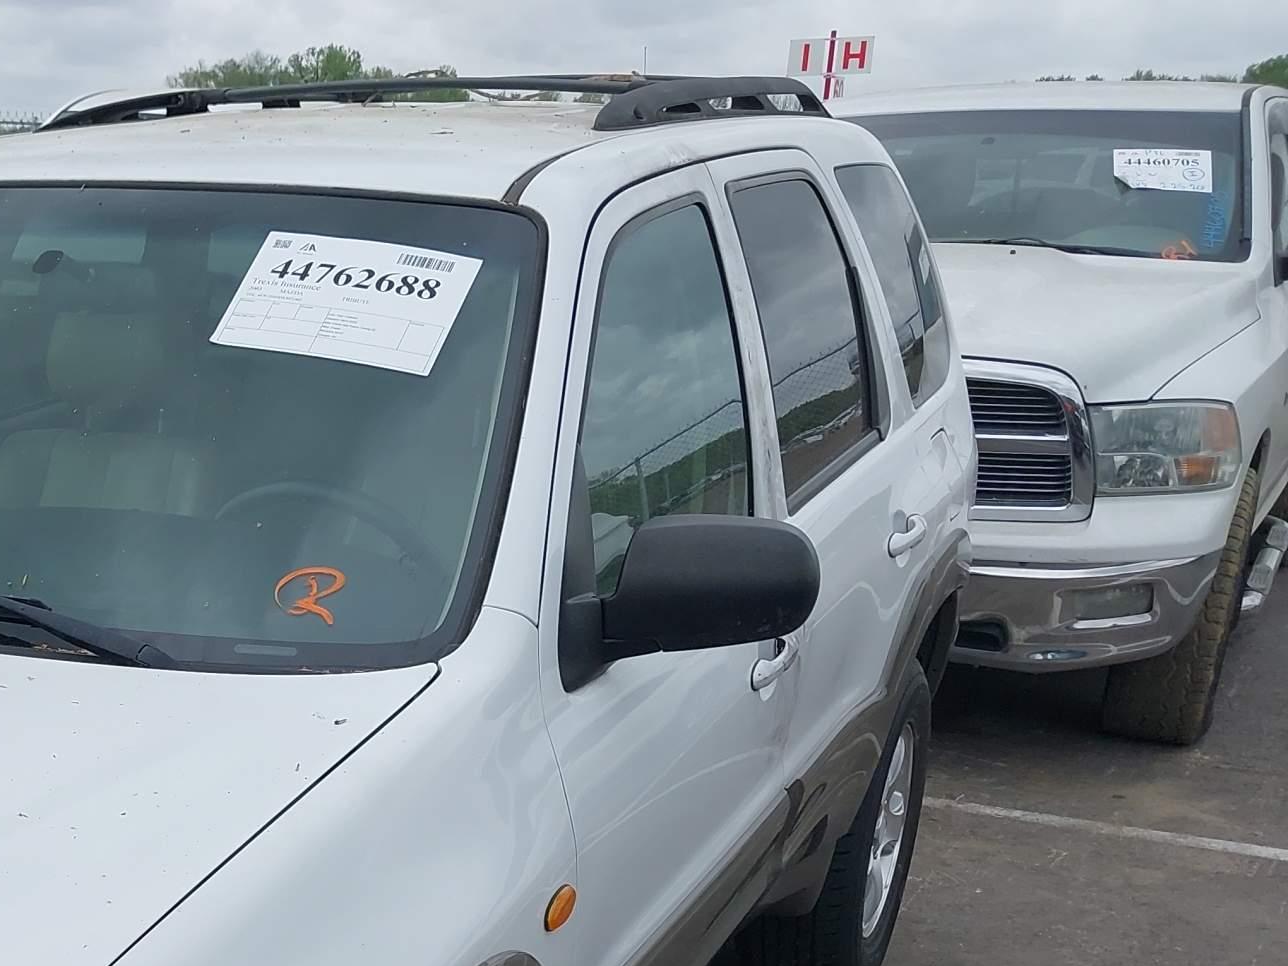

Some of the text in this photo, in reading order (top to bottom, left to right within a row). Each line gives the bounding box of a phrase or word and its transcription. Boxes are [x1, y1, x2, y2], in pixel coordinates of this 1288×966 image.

[842, 40, 868, 70] H
[1123, 158, 1201, 167] 44460705
[270, 258, 441, 301] 44762688
[279, 280, 322, 292] Insurance
